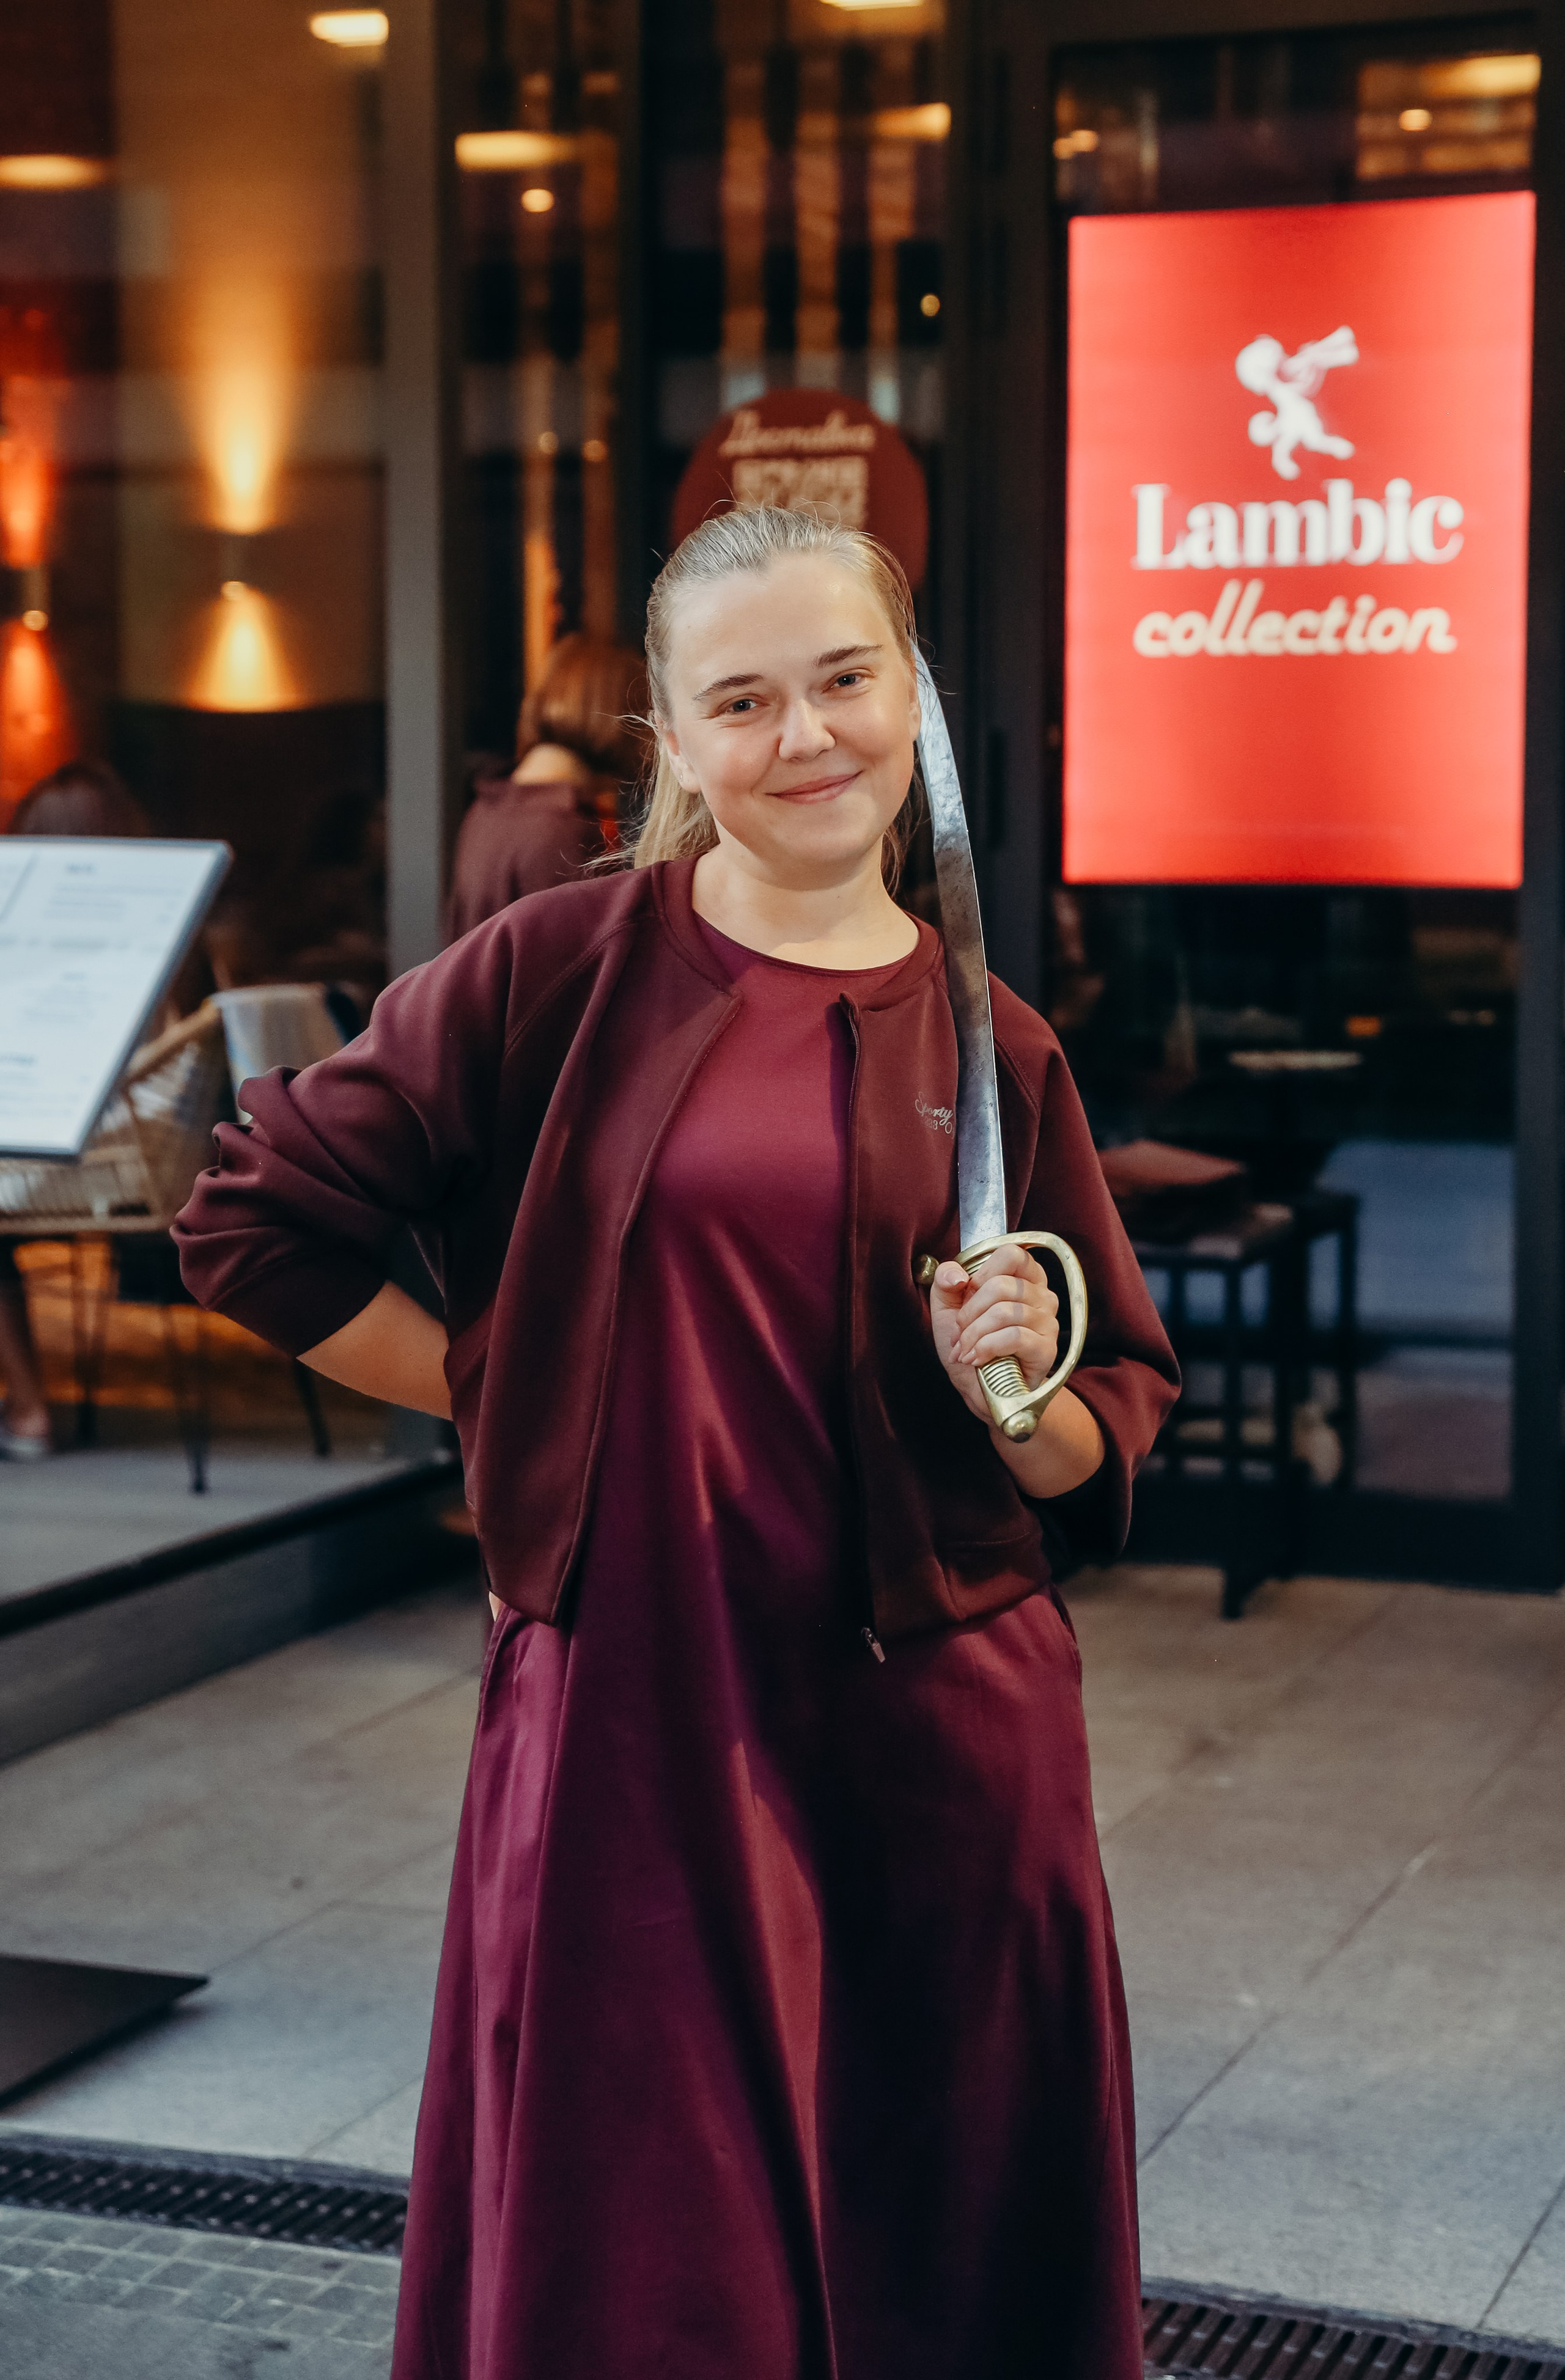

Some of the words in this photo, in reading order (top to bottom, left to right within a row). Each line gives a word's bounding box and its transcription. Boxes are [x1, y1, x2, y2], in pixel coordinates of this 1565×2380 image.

[1132, 478, 1464, 570] Lambic
[1133, 578, 1457, 658] collection
[915, 1091, 953, 1125] Sporty
